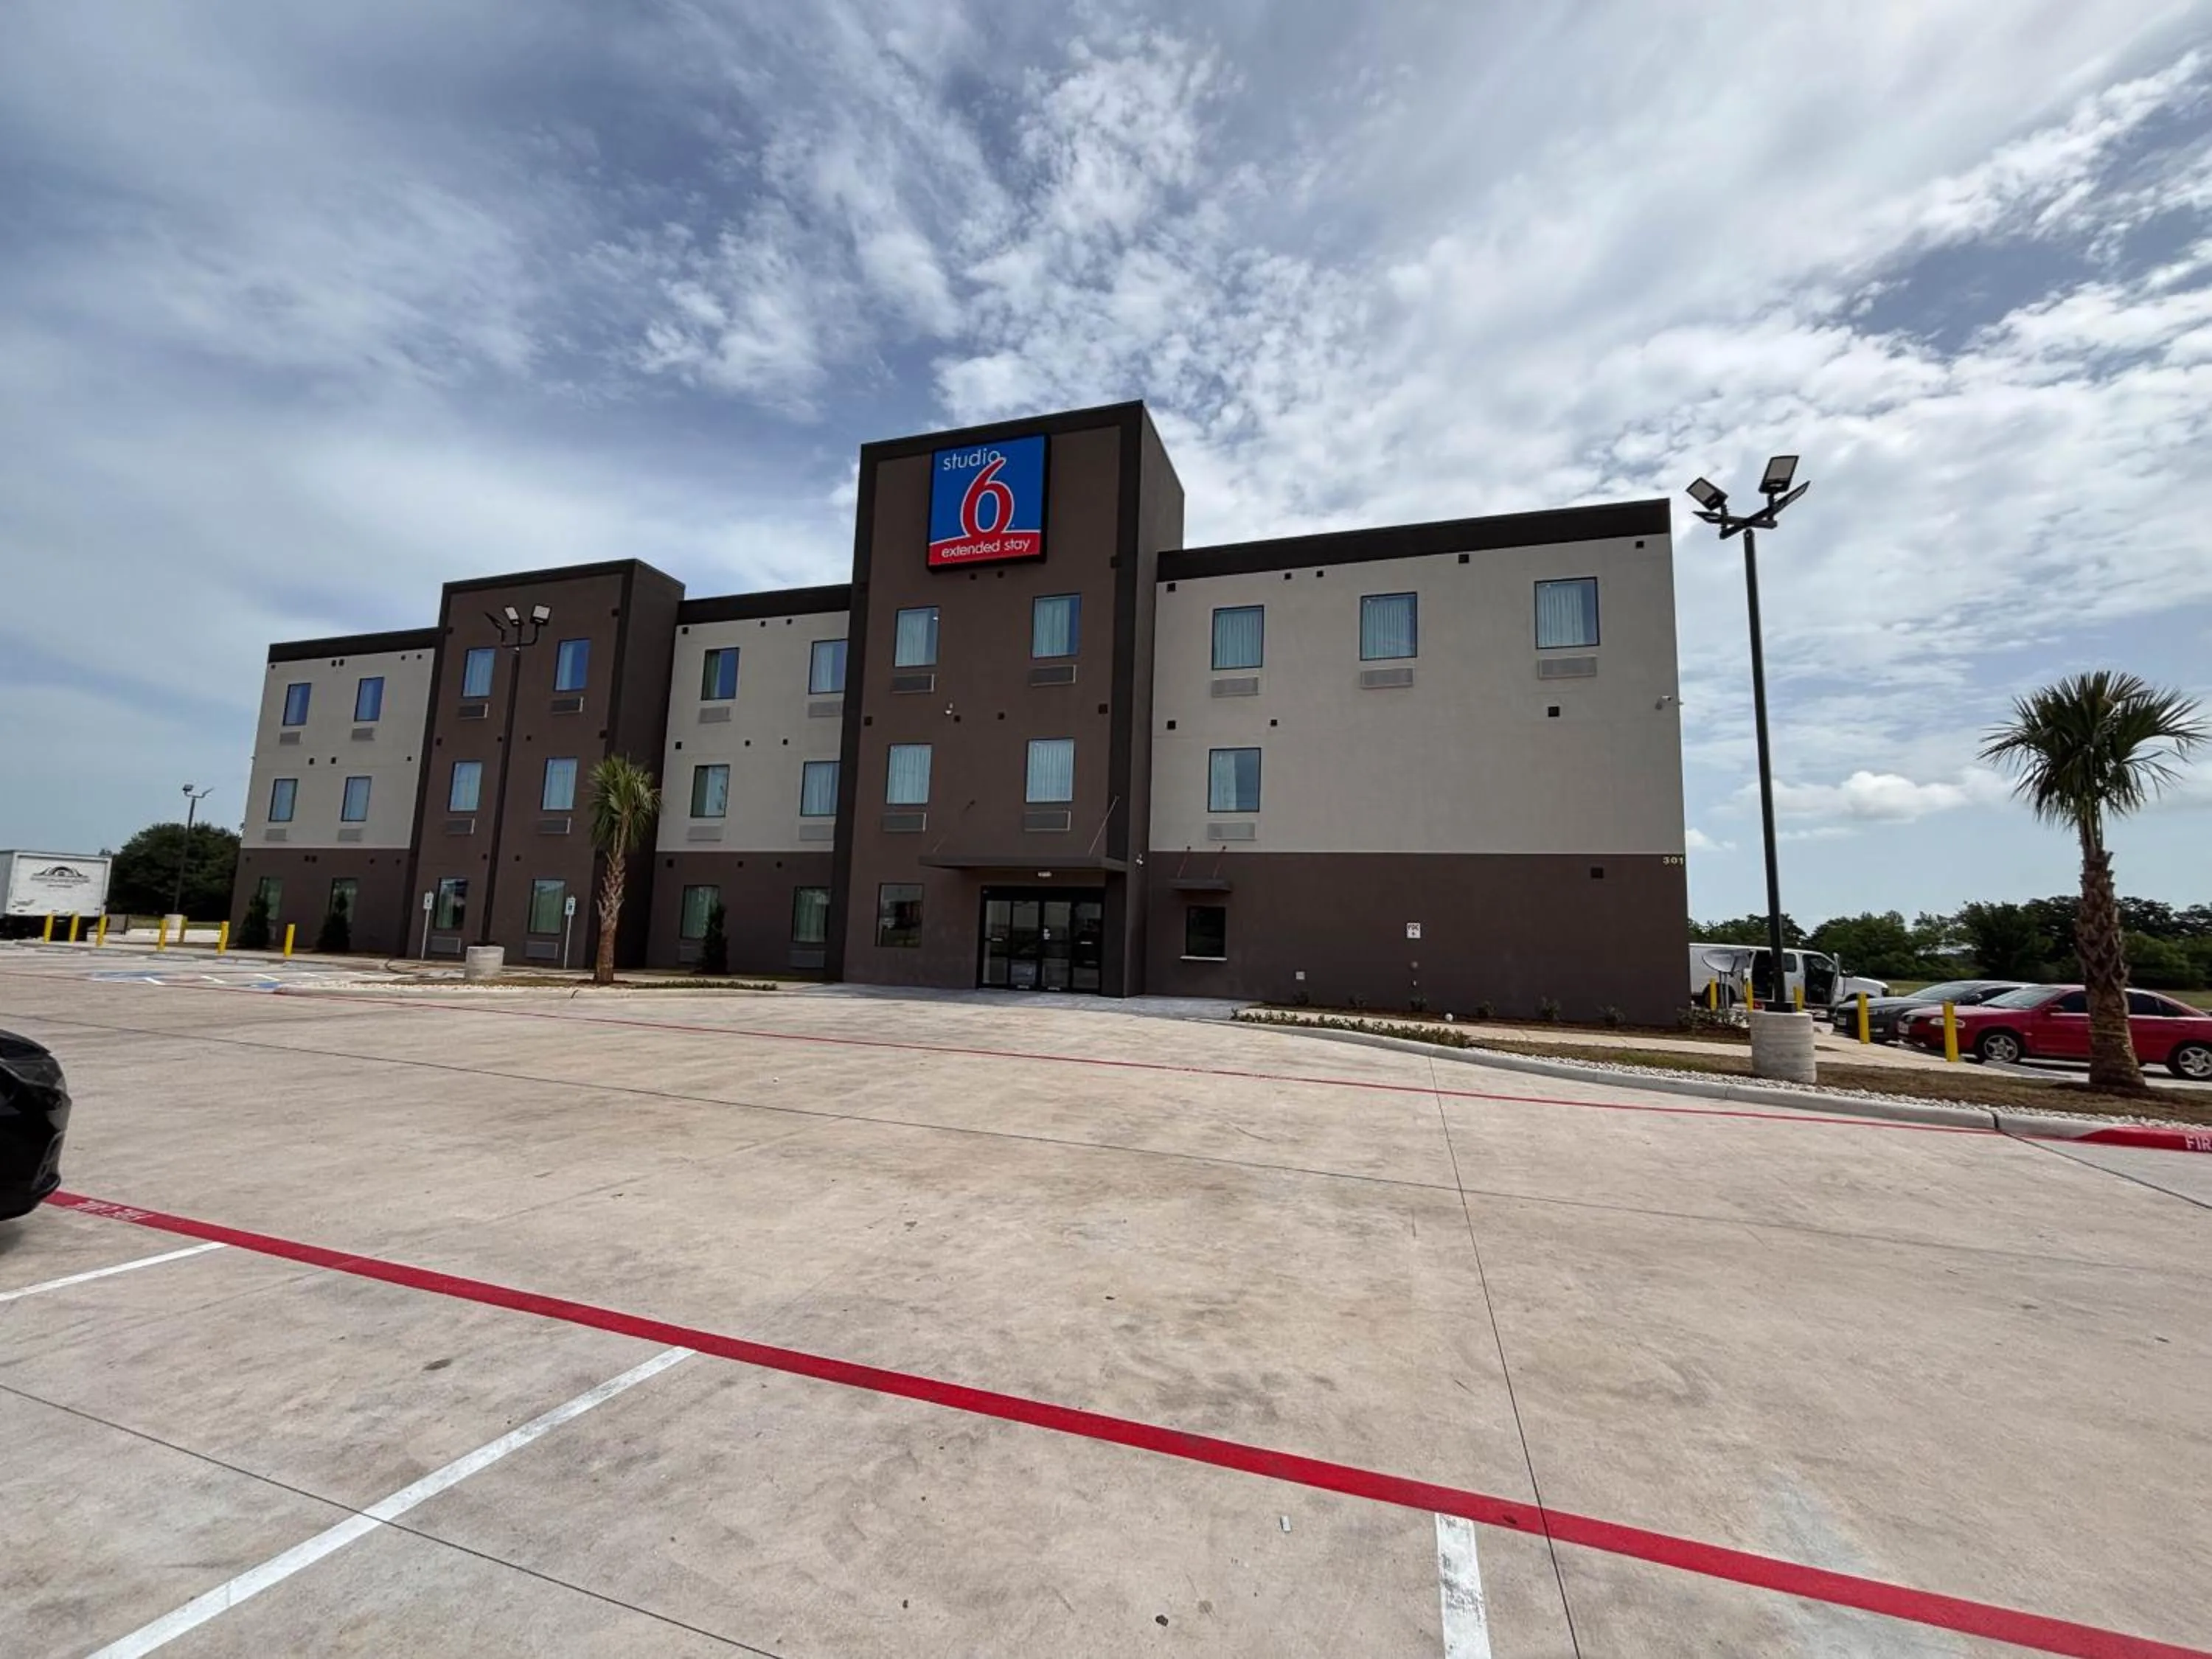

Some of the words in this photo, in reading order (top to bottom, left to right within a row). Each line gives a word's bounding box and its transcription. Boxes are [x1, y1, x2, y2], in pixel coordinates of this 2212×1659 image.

[943, 448, 1001, 470] studio
[960, 456, 1015, 536] 6
[942, 539, 1001, 557] extended
[1004, 538, 1031, 552] stay
[1663, 856, 1683, 866] 301
